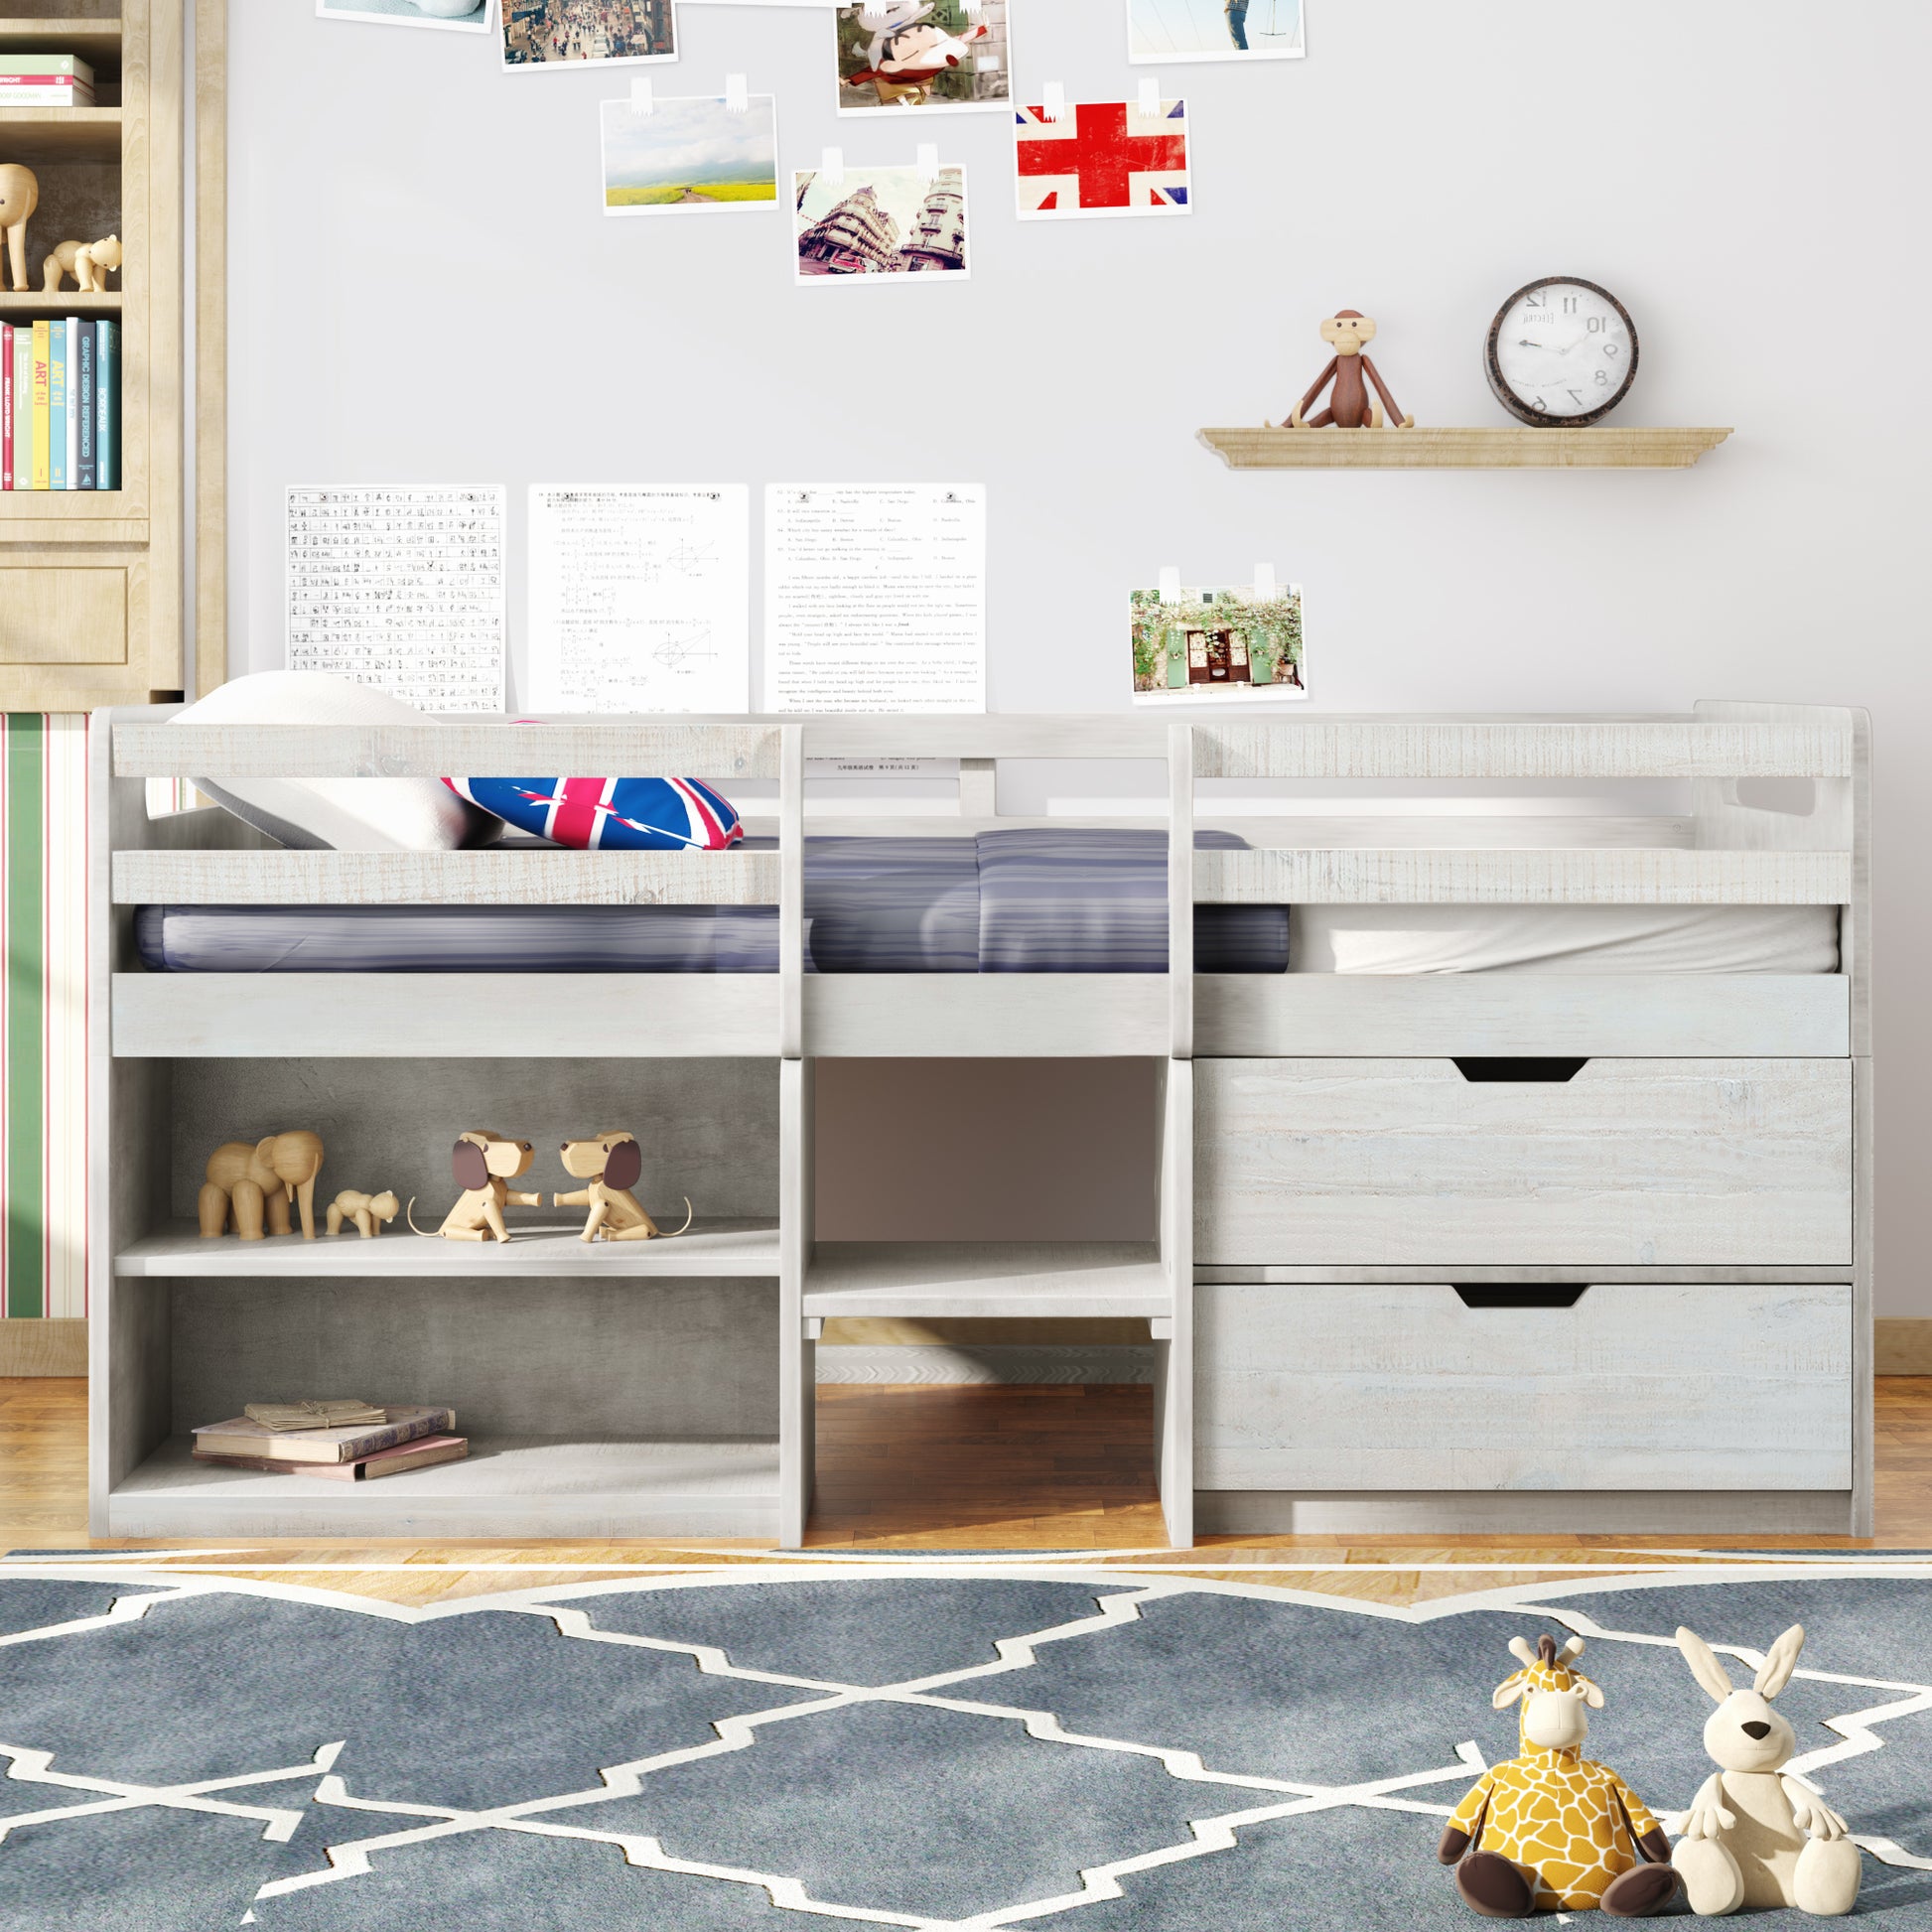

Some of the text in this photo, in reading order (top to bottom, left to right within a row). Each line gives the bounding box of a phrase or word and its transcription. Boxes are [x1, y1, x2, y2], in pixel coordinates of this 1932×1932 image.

[81, 337, 90, 372] GRAPHIC
[35, 360, 48, 387] ART
[52, 360, 65, 388] ART
[81, 373, 90, 404] DESIGN
[97, 387, 107, 432] BORDEAUX
[81, 405, 90, 458] REFERENCED
